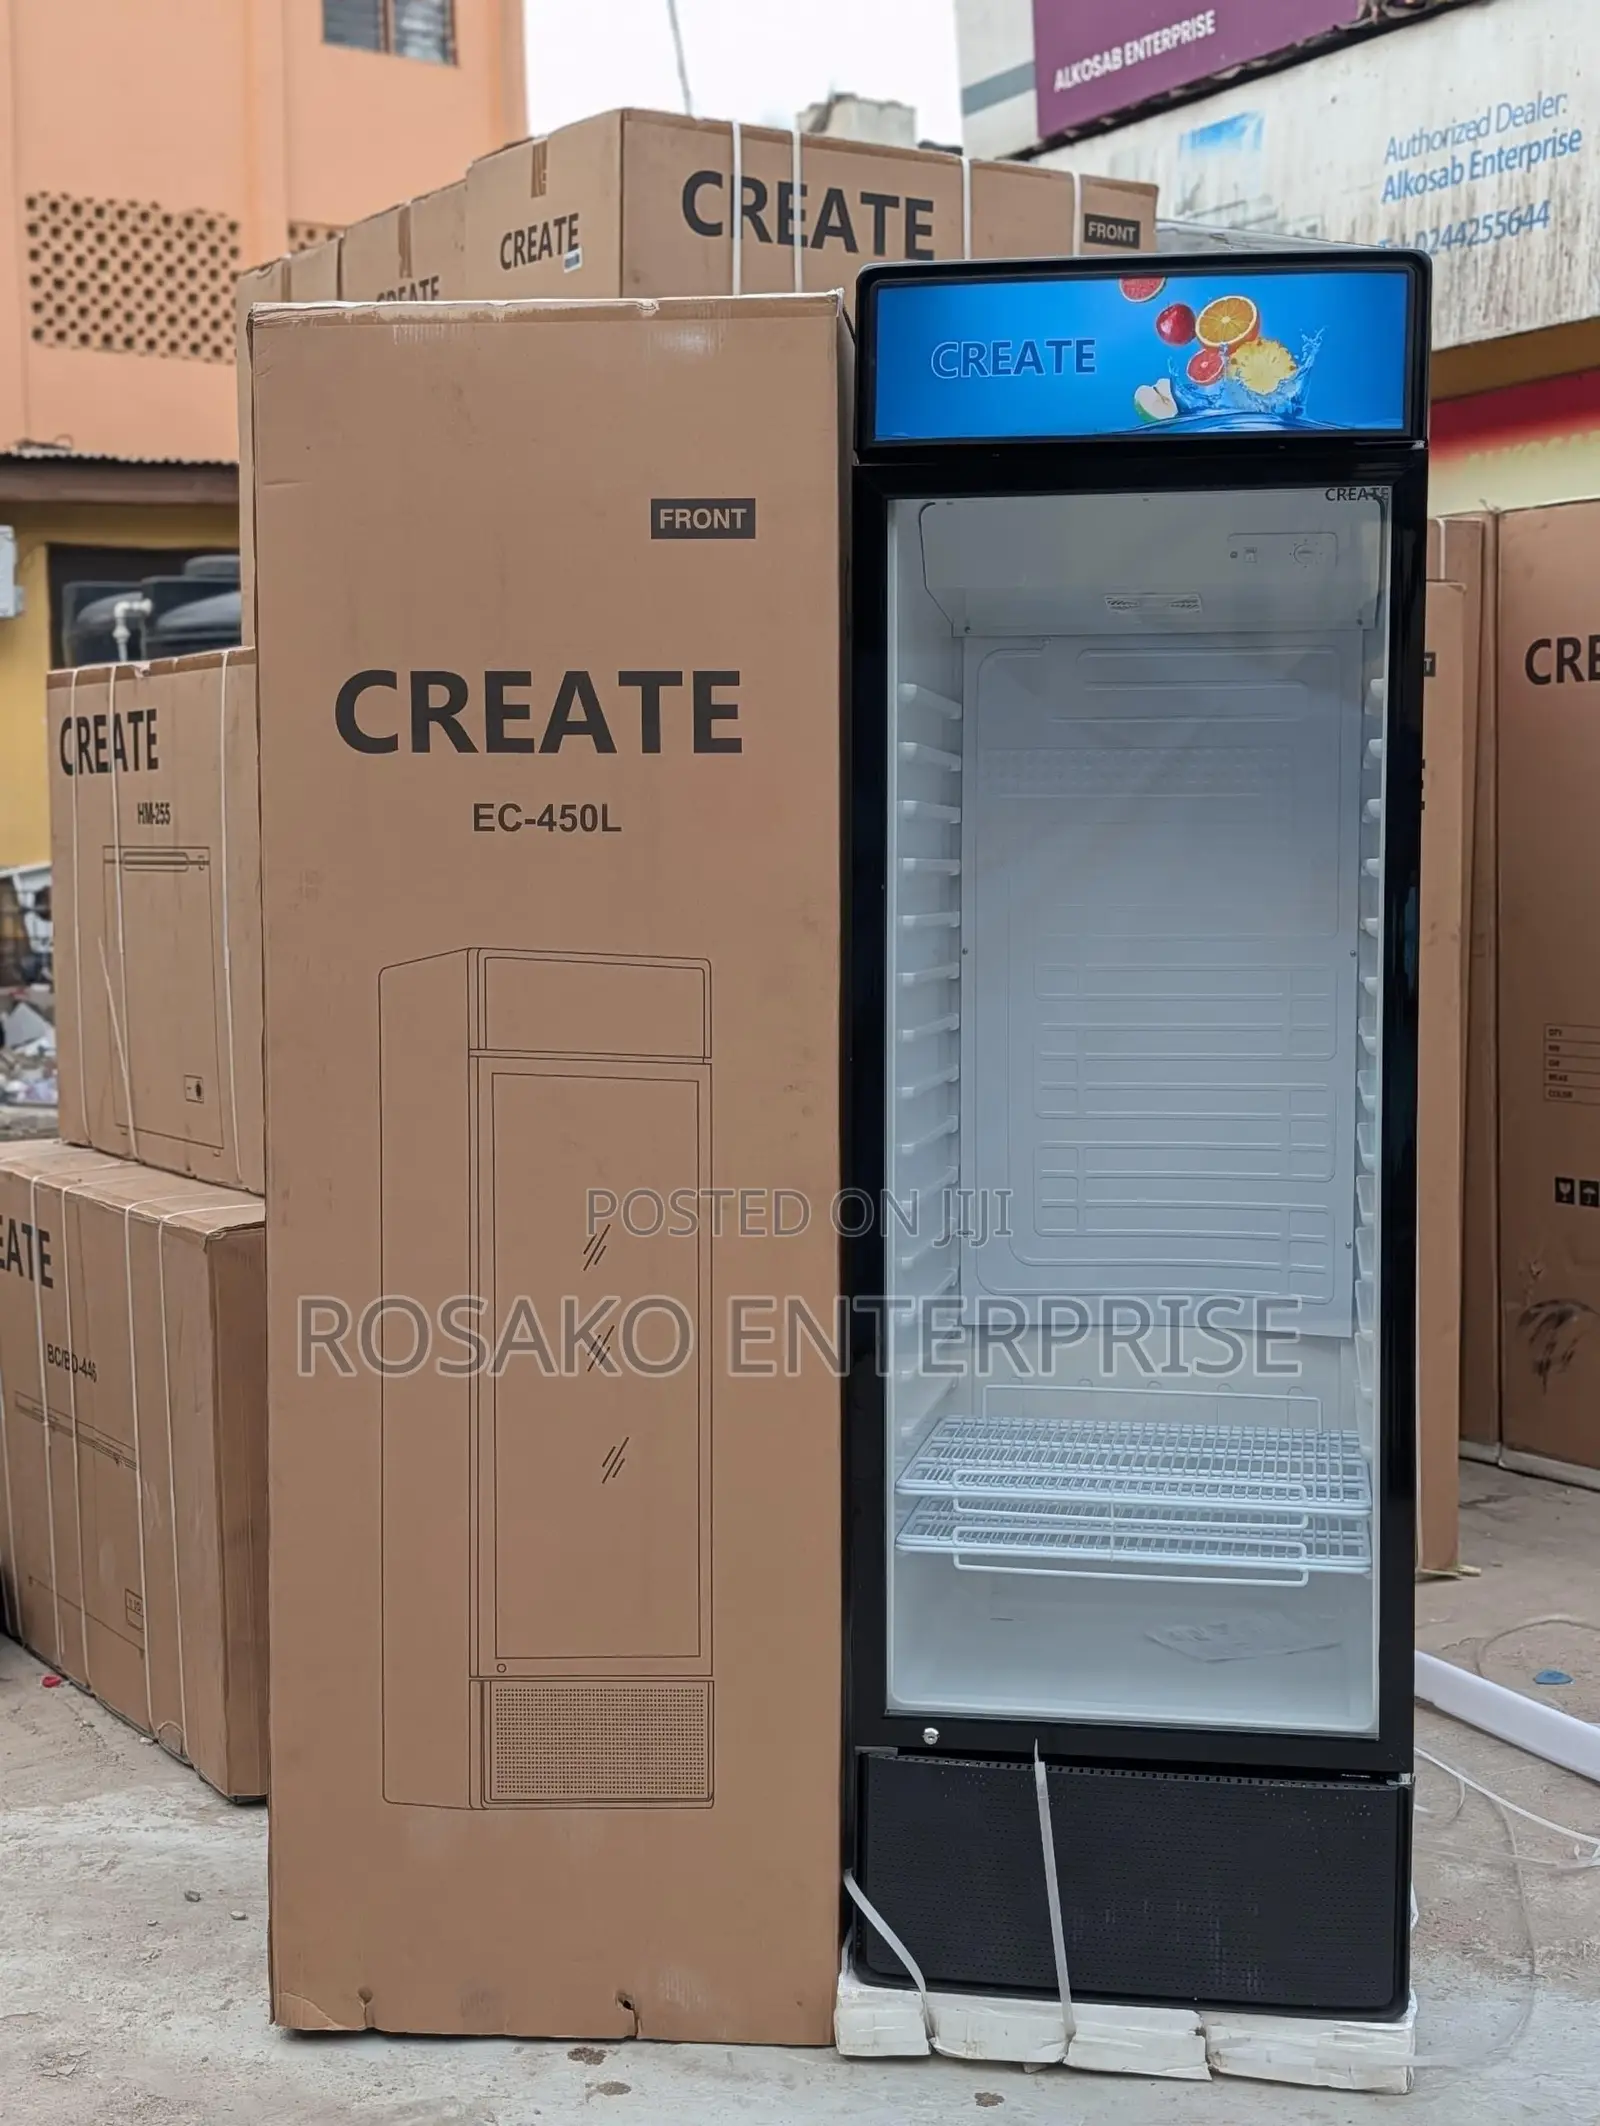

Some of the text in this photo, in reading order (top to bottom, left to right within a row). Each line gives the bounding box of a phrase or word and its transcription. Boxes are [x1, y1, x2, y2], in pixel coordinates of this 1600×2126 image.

[1054, 10, 1215, 92] ALKOSAB ENTERPRISE
[1384, 91, 1567, 164] Authorized Dealer:
[1381, 128, 1582, 203] Alkosab Enterprise
[500, 213, 579, 270] CREATE
[682, 170, 935, 261] CREATE
[1088, 221, 1137, 242] FRONT
[931, 338, 1096, 379] CREATE
[660, 508, 747, 529] FRONT
[1325, 487, 1389, 501] CREATE
[60, 708, 159, 776] CREATE
[335, 669, 742, 754] CREATE
[473, 803, 622, 832] EC-450L
